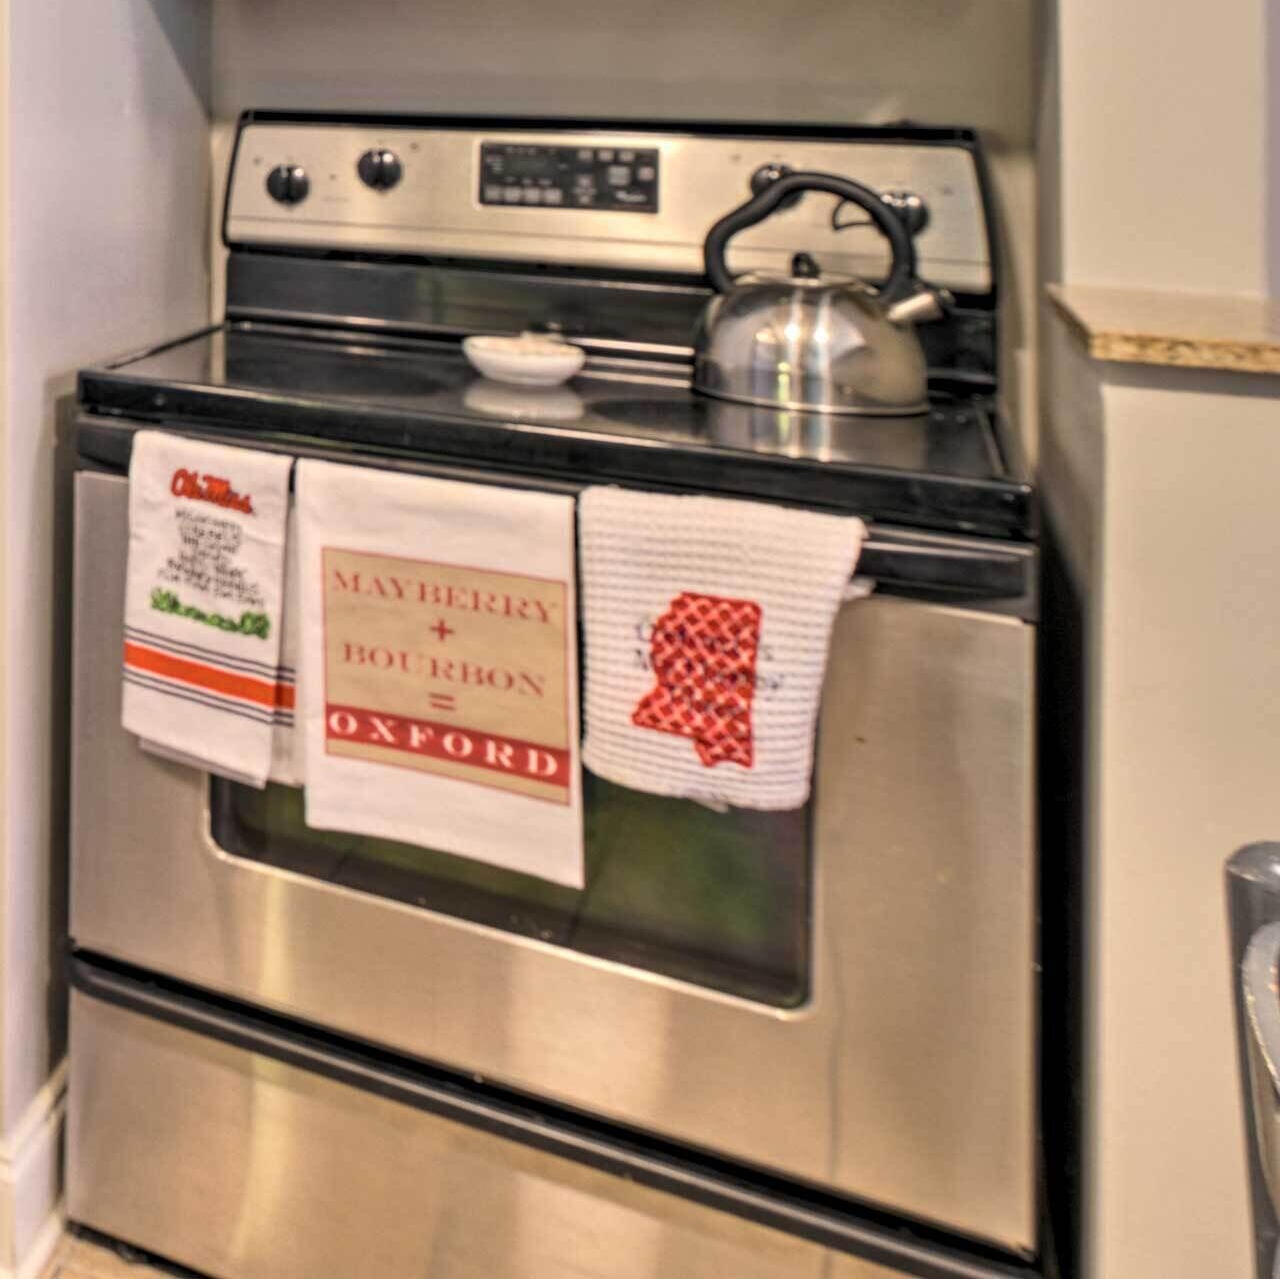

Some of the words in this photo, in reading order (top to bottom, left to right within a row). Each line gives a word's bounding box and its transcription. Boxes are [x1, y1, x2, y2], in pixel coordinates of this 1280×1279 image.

[333, 569, 559, 625] MAYBERRY
[342, 642, 546, 698] BOURBON
[328, 710, 559, 778] OXFORD
